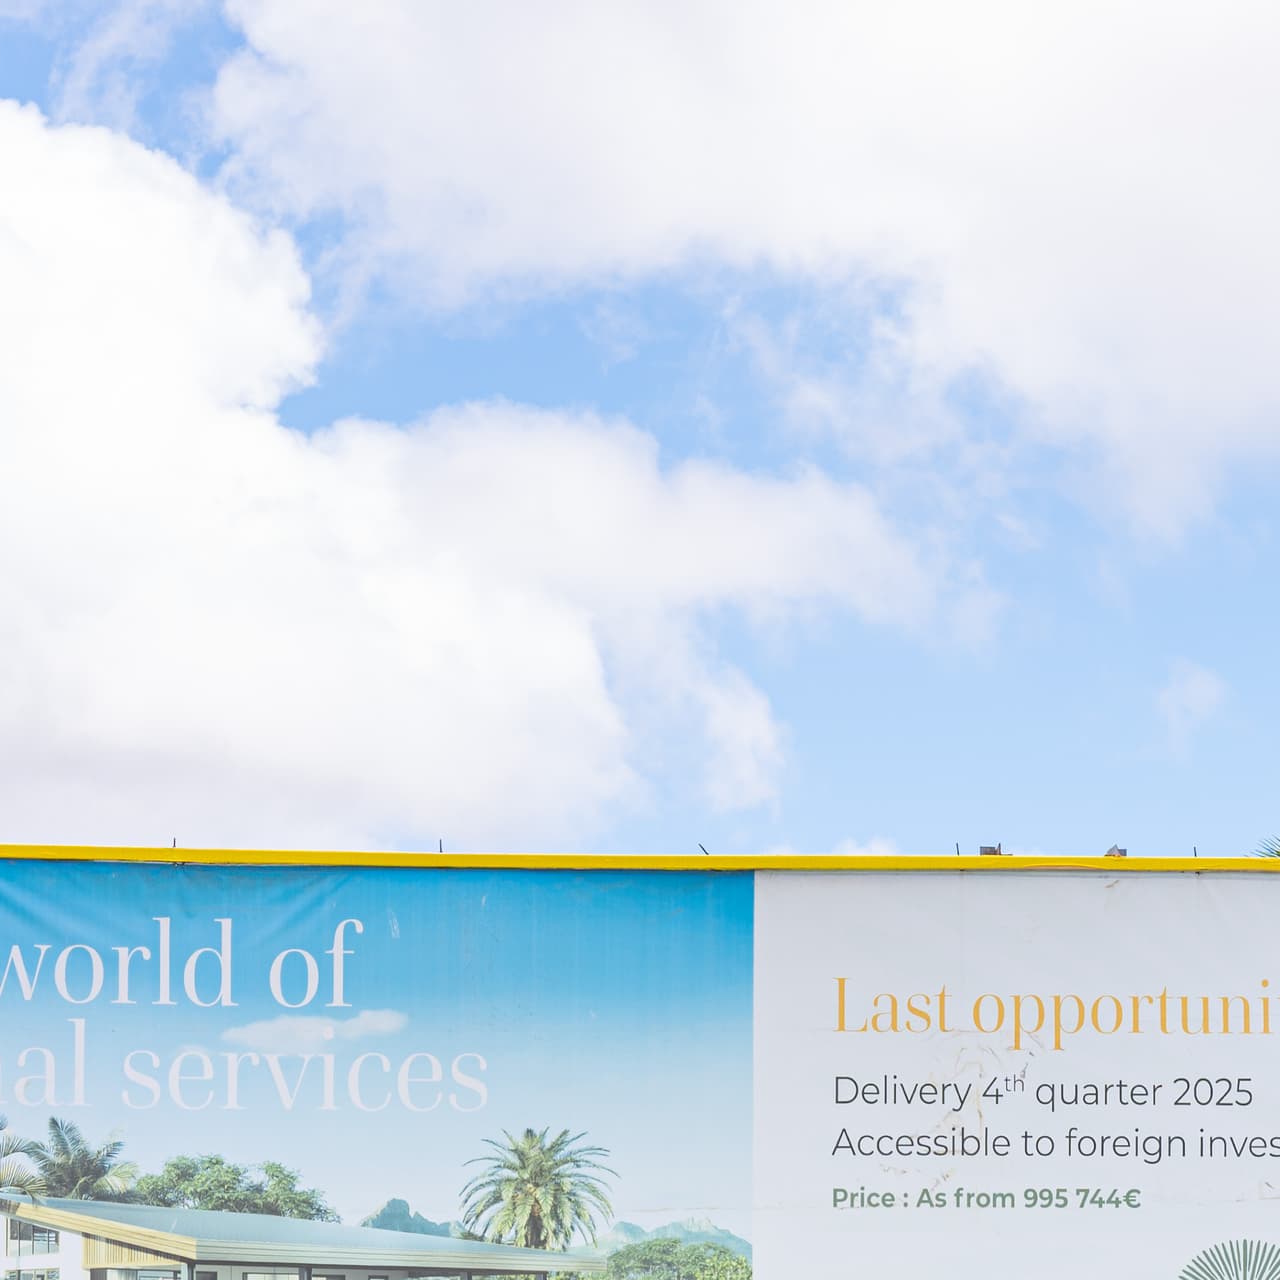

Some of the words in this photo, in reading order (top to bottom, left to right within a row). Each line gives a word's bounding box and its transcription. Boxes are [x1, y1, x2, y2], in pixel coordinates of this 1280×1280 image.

[268, 917, 364, 1008] of
[831, 976, 954, 1034] Last
[121, 1025, 489, 1112] services
[832, 1074, 972, 1112] Delivery
[1035, 1077, 1163, 1113] quarter
[1173, 1076, 1254, 1107] 2025
[831, 1126, 1012, 1158] Accessible
[1021, 1129, 1055, 1158] to
[1065, 1126, 1187, 1165] foreign
[831, 1186, 896, 1209] Price
[915, 1187, 947, 1209] As
[953, 1186, 1016, 1209] from
[1023, 1187, 1068, 1209] 995
[1075, 1187, 1142, 1210] 744€
